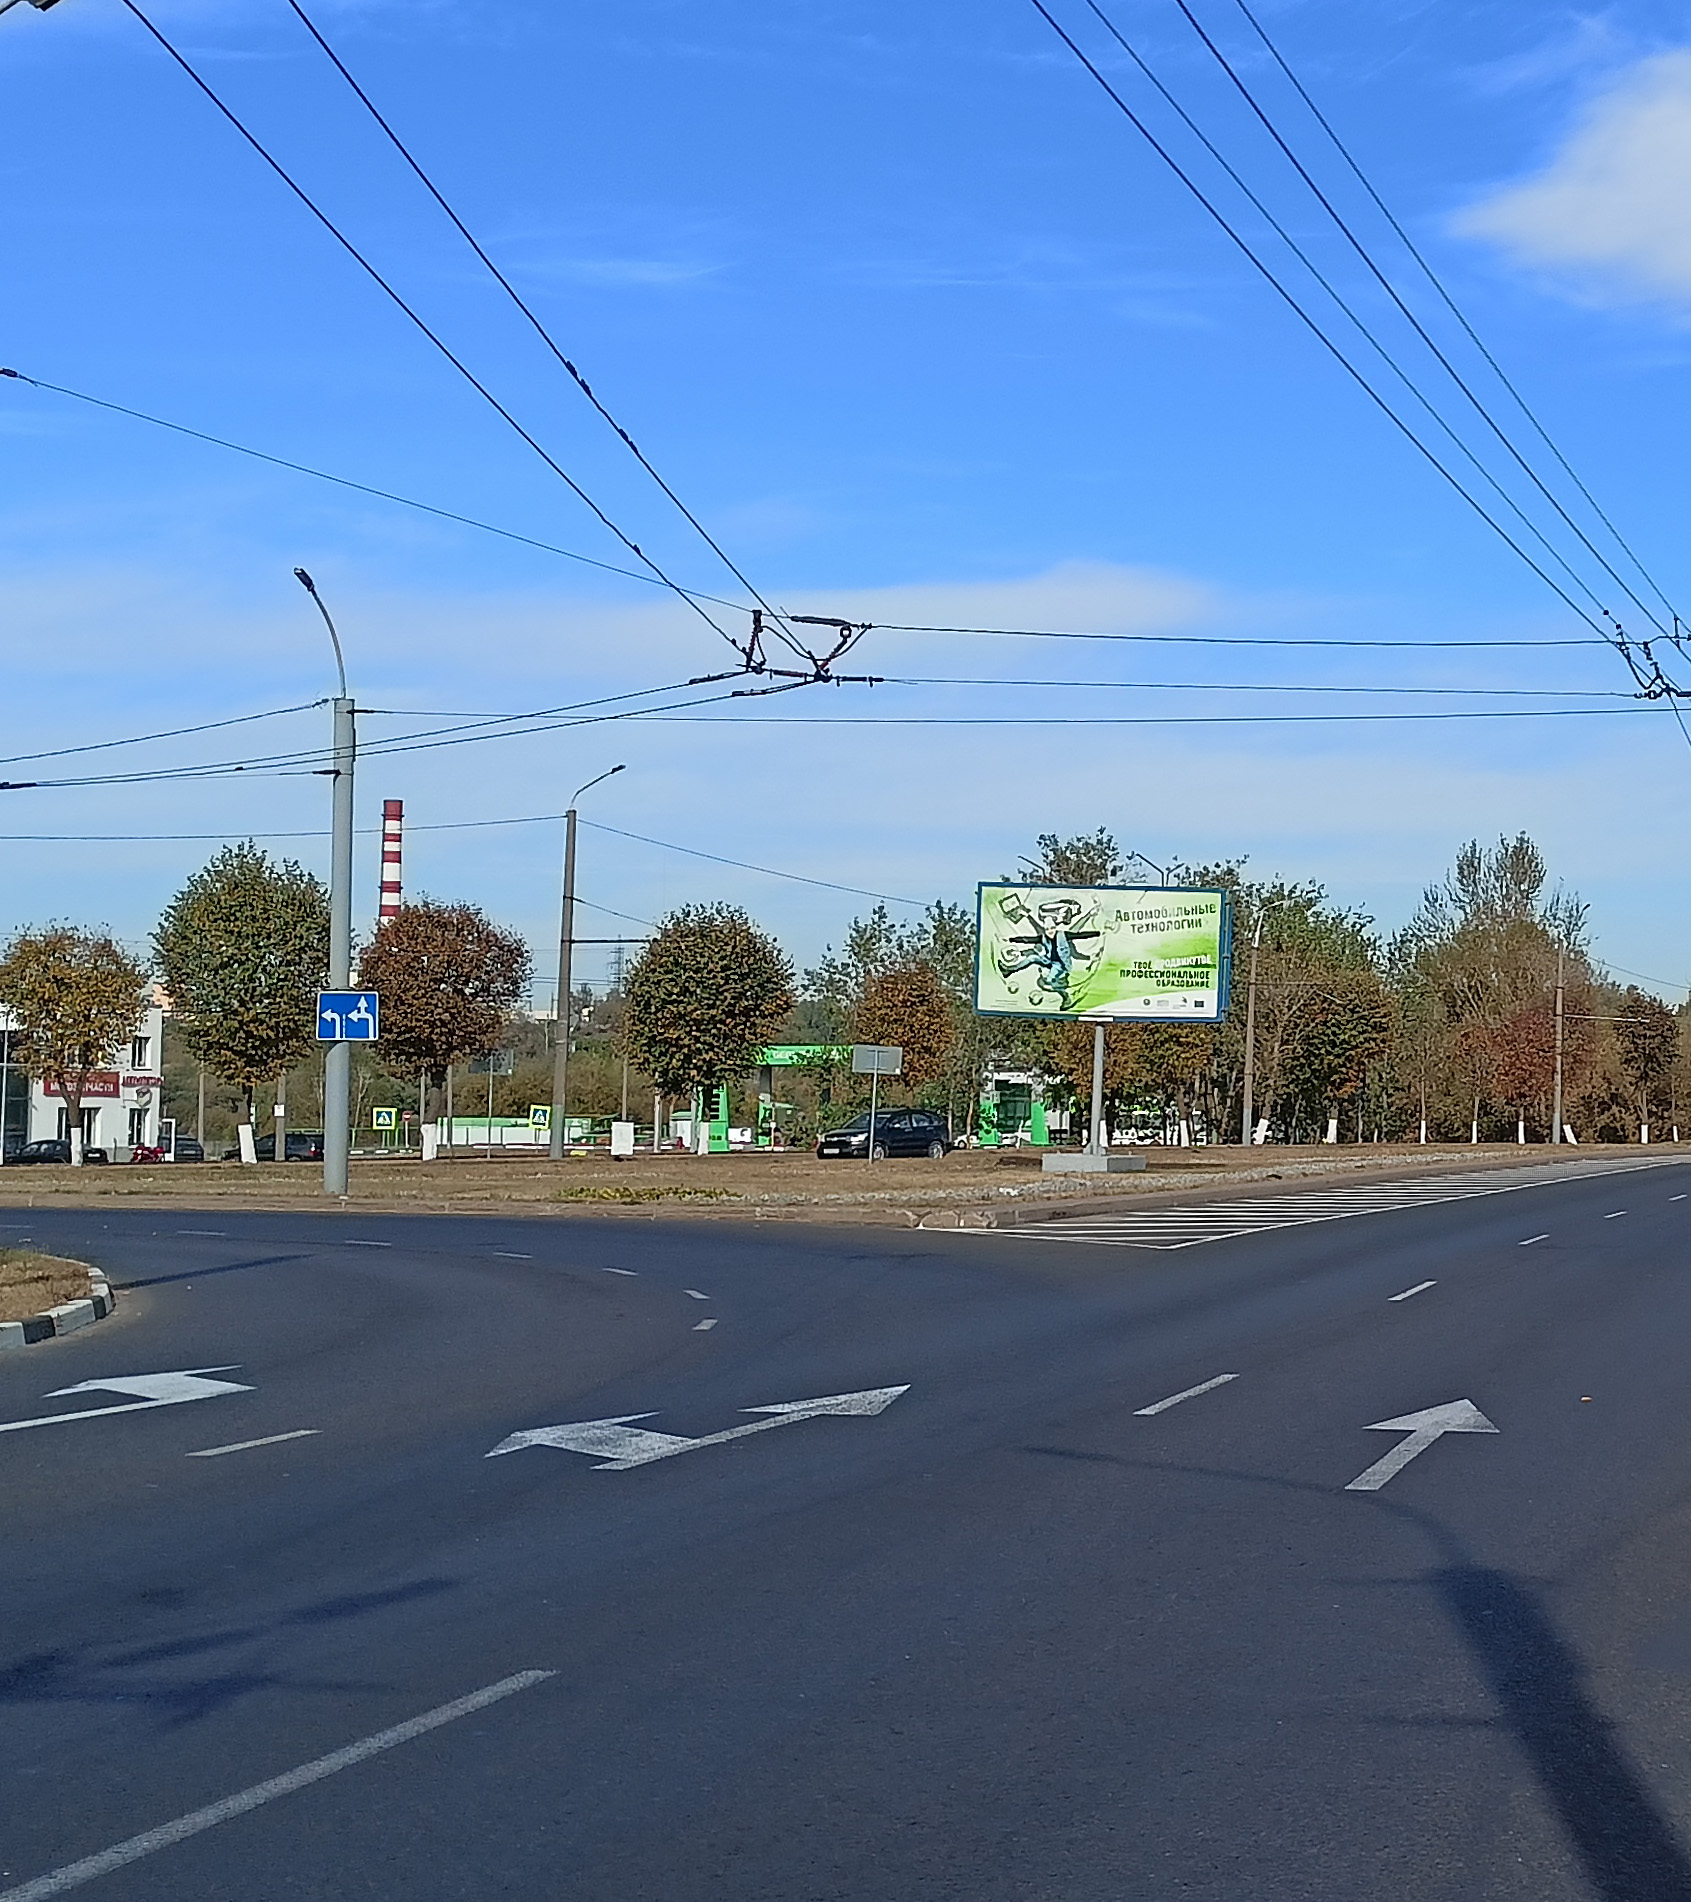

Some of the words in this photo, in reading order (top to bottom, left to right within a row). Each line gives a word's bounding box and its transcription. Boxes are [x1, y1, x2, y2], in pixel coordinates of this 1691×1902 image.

[1115, 903, 1217, 922] Автомобильные
[1130, 918, 1202, 934] технологии
[1119, 969, 1211, 980] ПРОФЕССИОНАЛЬНОЕ
